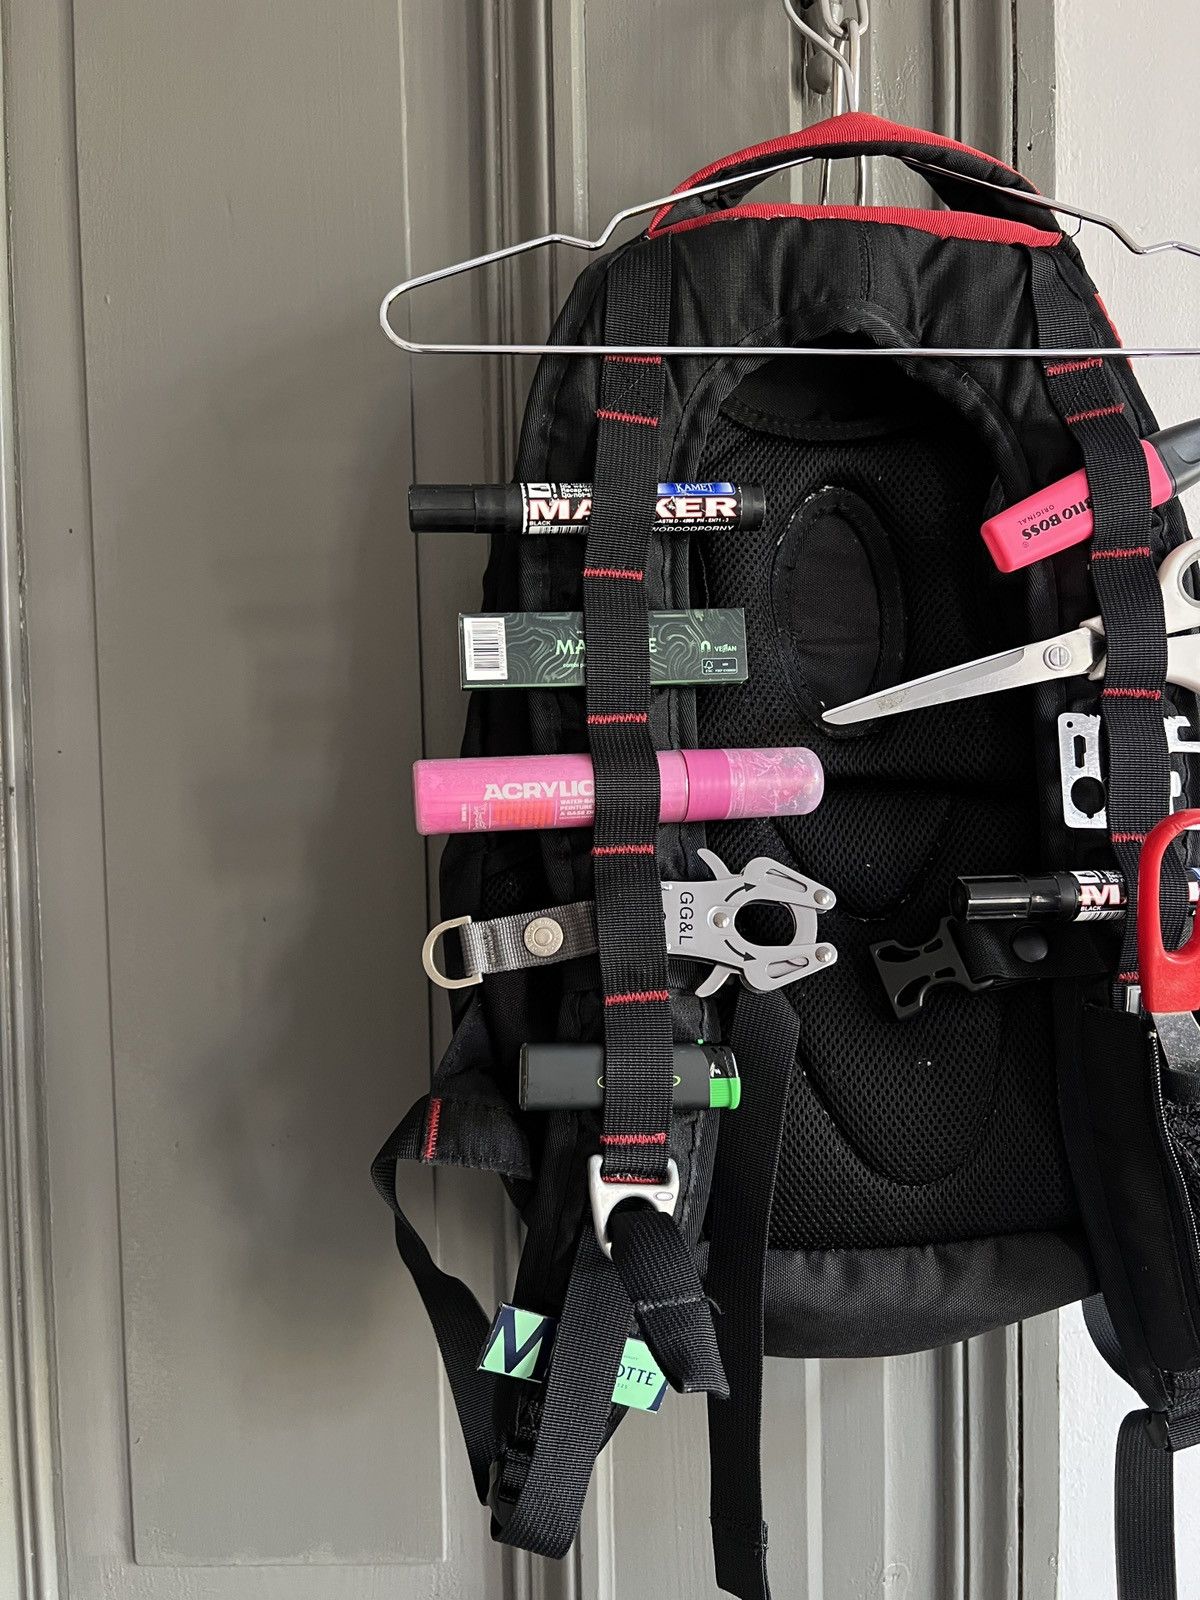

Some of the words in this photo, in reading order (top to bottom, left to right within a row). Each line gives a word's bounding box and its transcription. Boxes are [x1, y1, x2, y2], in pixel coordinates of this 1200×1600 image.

[675, 483, 714, 493] KAMET
[529, 496, 737, 520] MAKER
[1017, 504, 1055, 526] ORIGINAL
[1021, 513, 1062, 541] BOSS
[483, 780, 594, 801] ACRYLIC
[678, 891, 695, 945] GG&L
